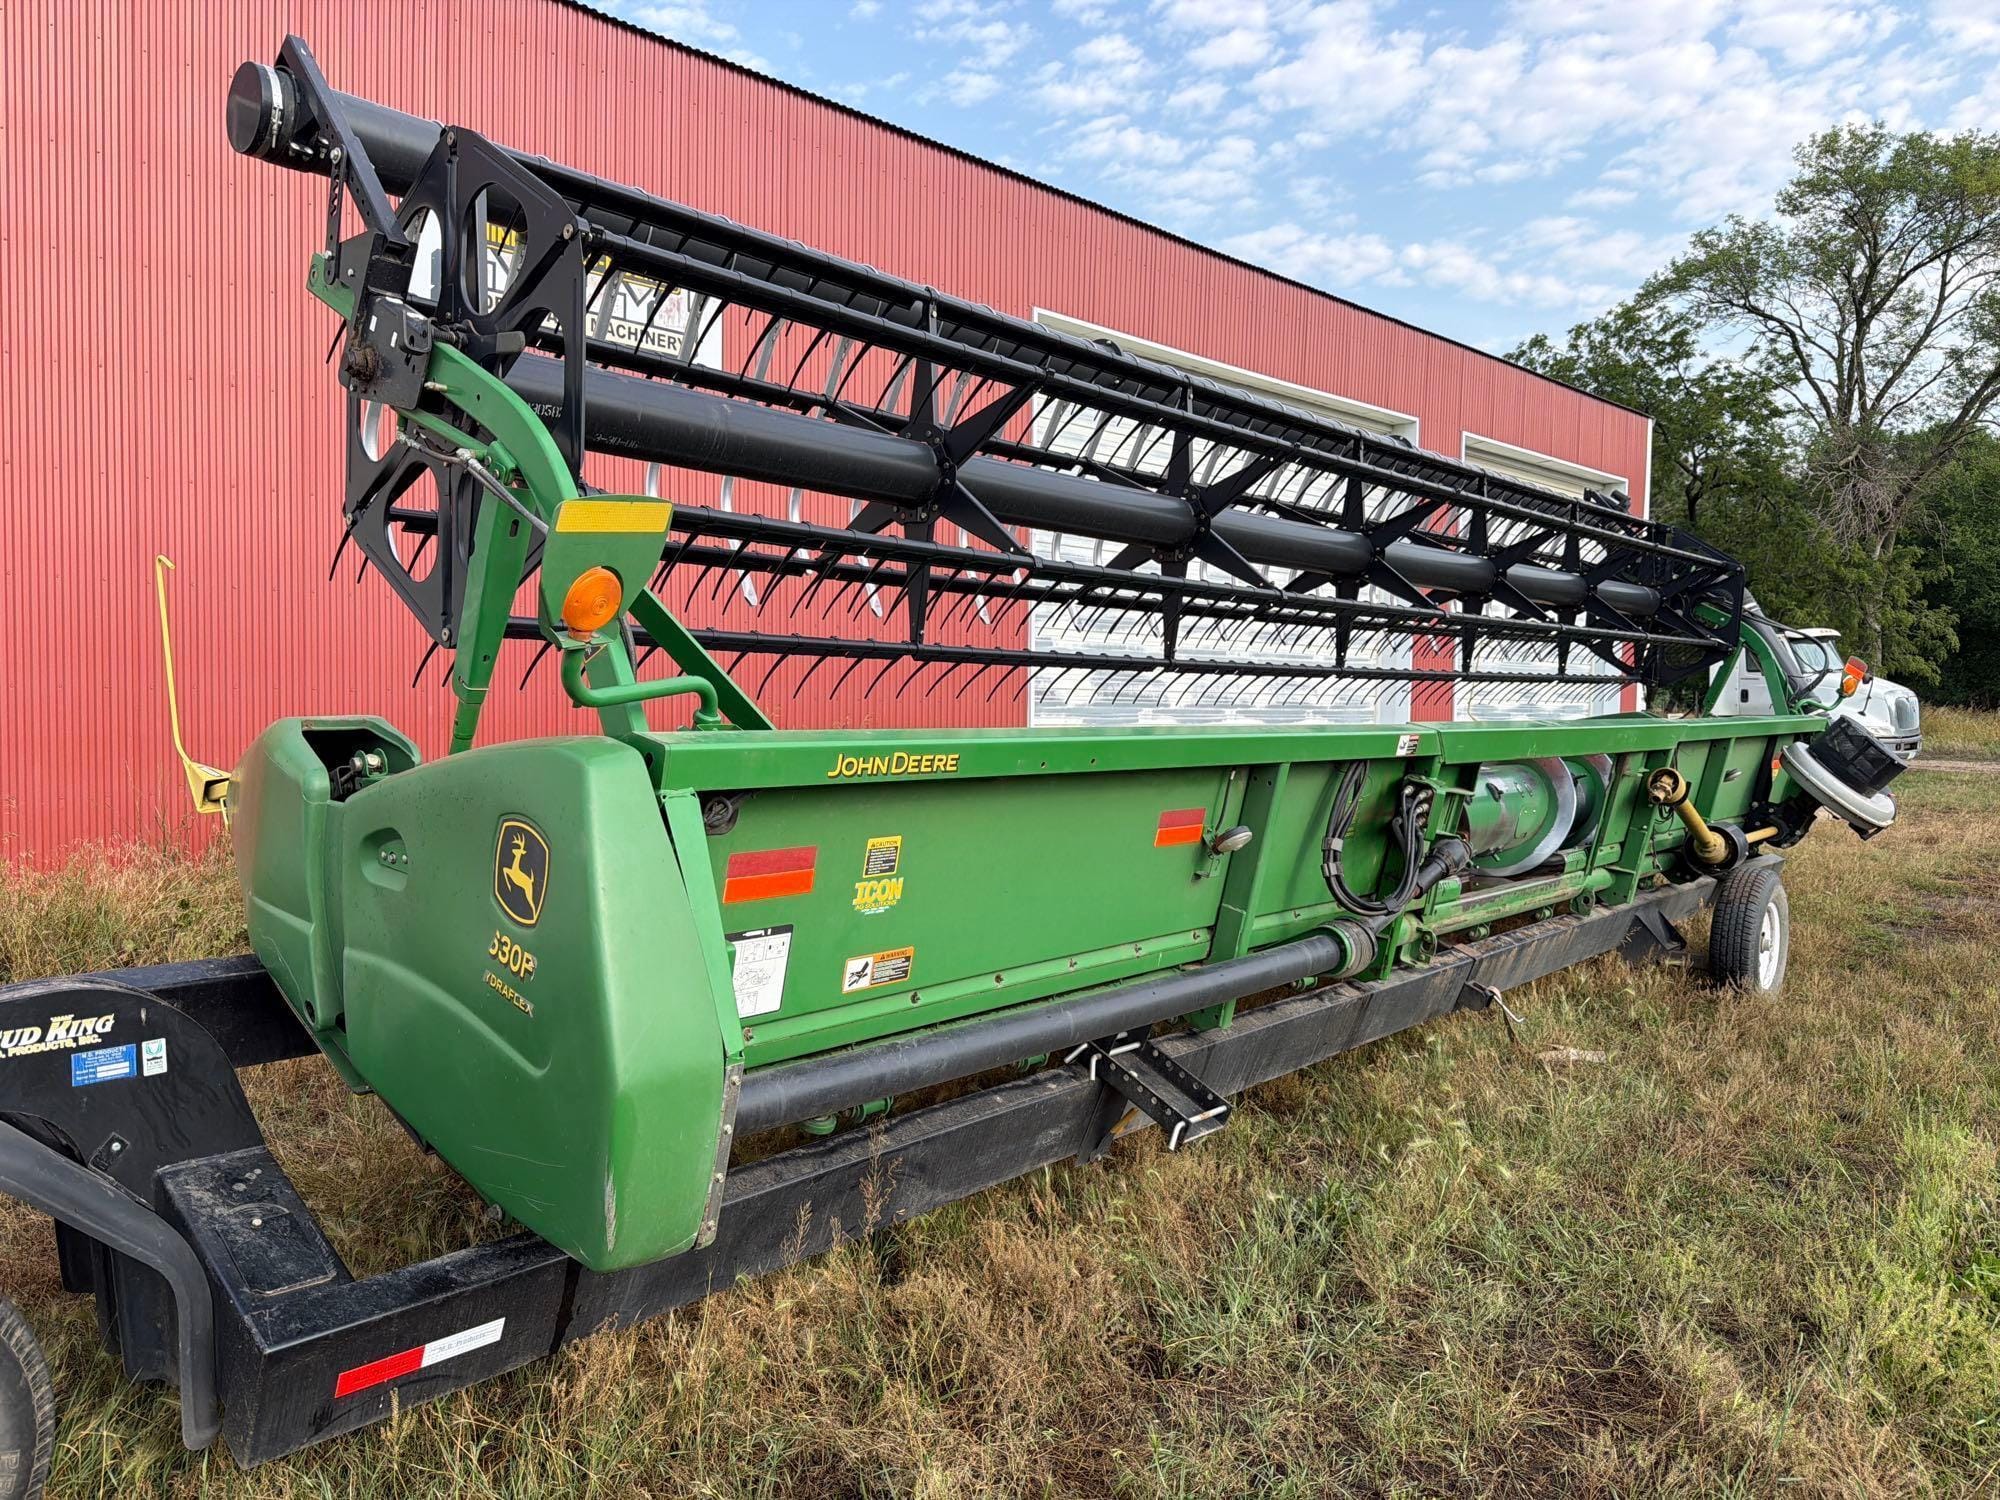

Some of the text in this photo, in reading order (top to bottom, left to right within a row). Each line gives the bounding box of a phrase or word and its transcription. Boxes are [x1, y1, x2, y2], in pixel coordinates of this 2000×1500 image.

[827, 752, 960, 777] JOHN DEERE
[852, 877, 904, 906] ICON
[0, 1013, 115, 1049] UD KING
